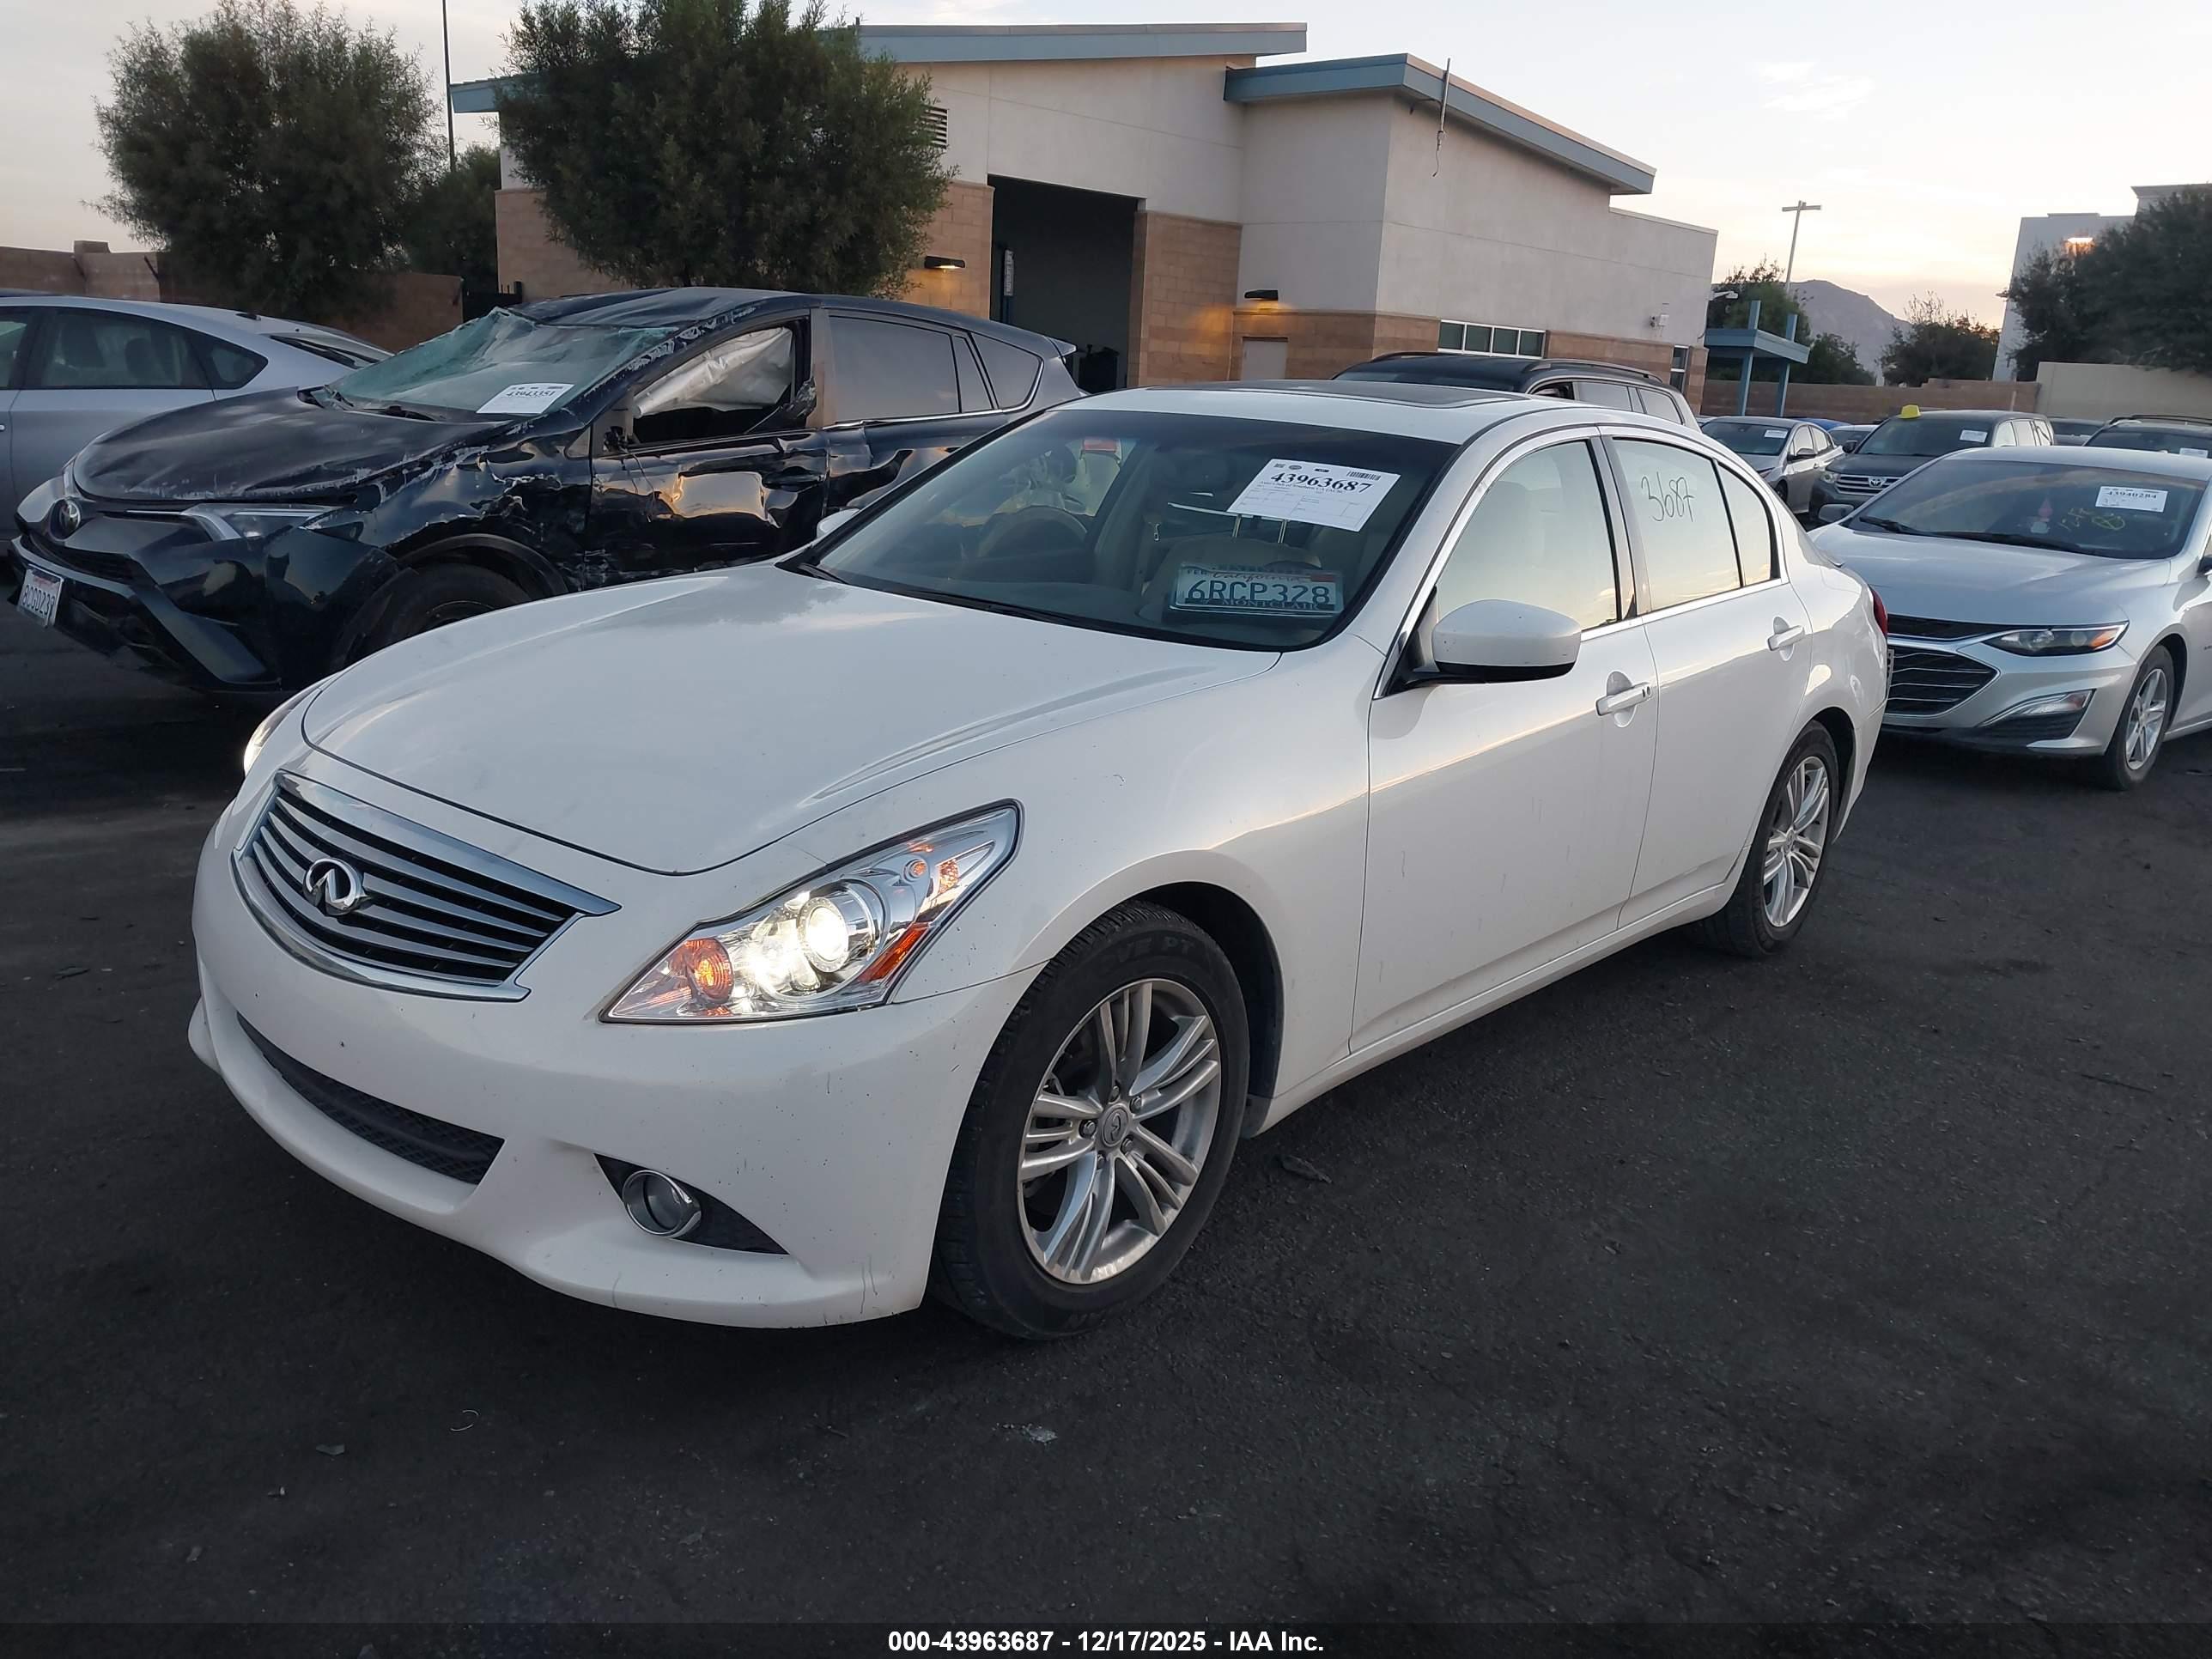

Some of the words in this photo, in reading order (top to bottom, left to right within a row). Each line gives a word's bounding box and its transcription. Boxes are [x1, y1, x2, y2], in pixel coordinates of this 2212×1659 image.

[1270, 472, 1373, 494] 43963687
[1640, 471, 1695, 523] 3687
[1188, 579, 1330, 606] 6RCP328
